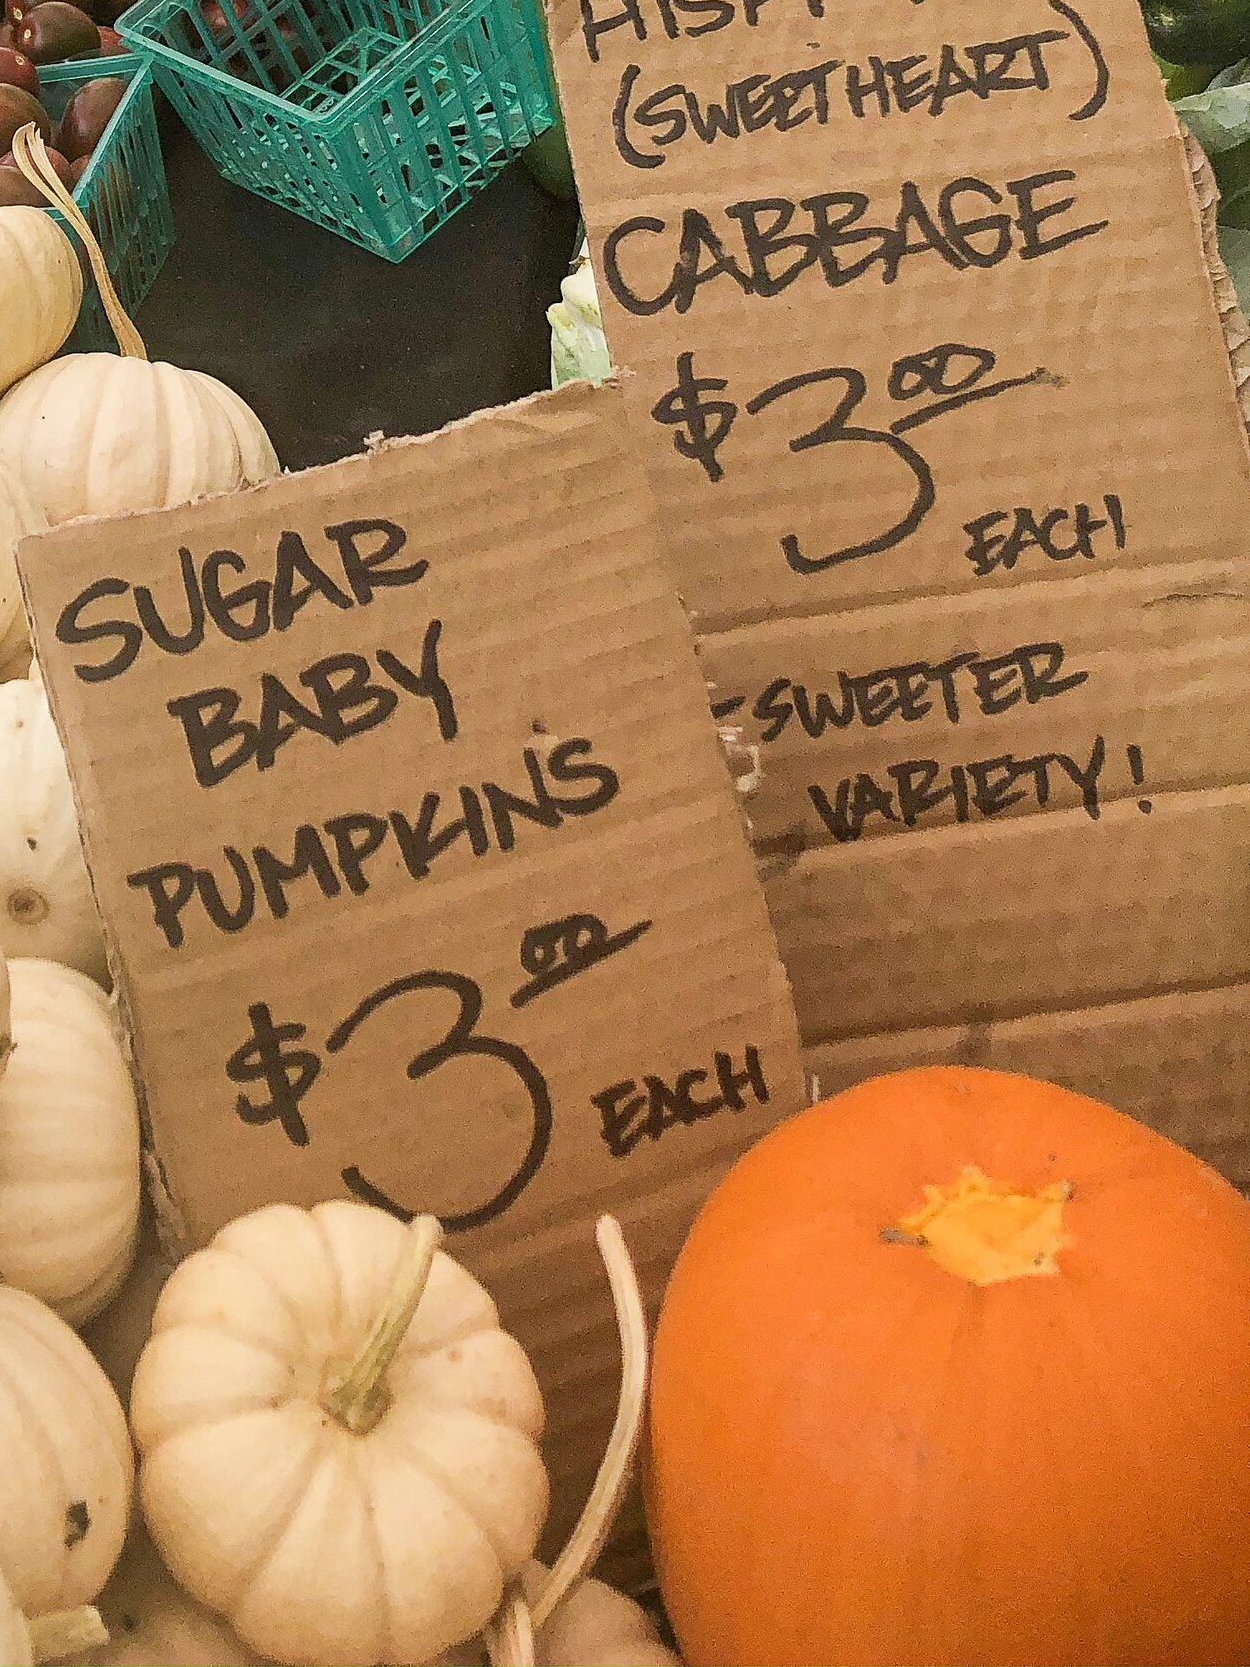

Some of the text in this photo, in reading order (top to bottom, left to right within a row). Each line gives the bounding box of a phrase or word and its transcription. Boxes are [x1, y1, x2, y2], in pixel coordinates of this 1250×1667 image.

[602, 169, 1109, 317] CABBAGE
[54, 517, 429, 684] SUGAR
[963, 493, 1128, 577] EACH
[166, 619, 459, 789] BABY
[126, 737, 621, 948] PUMPKINS
[807, 734, 1154, 842] VARIETY!
[590, 1046, 771, 1159] EACH
